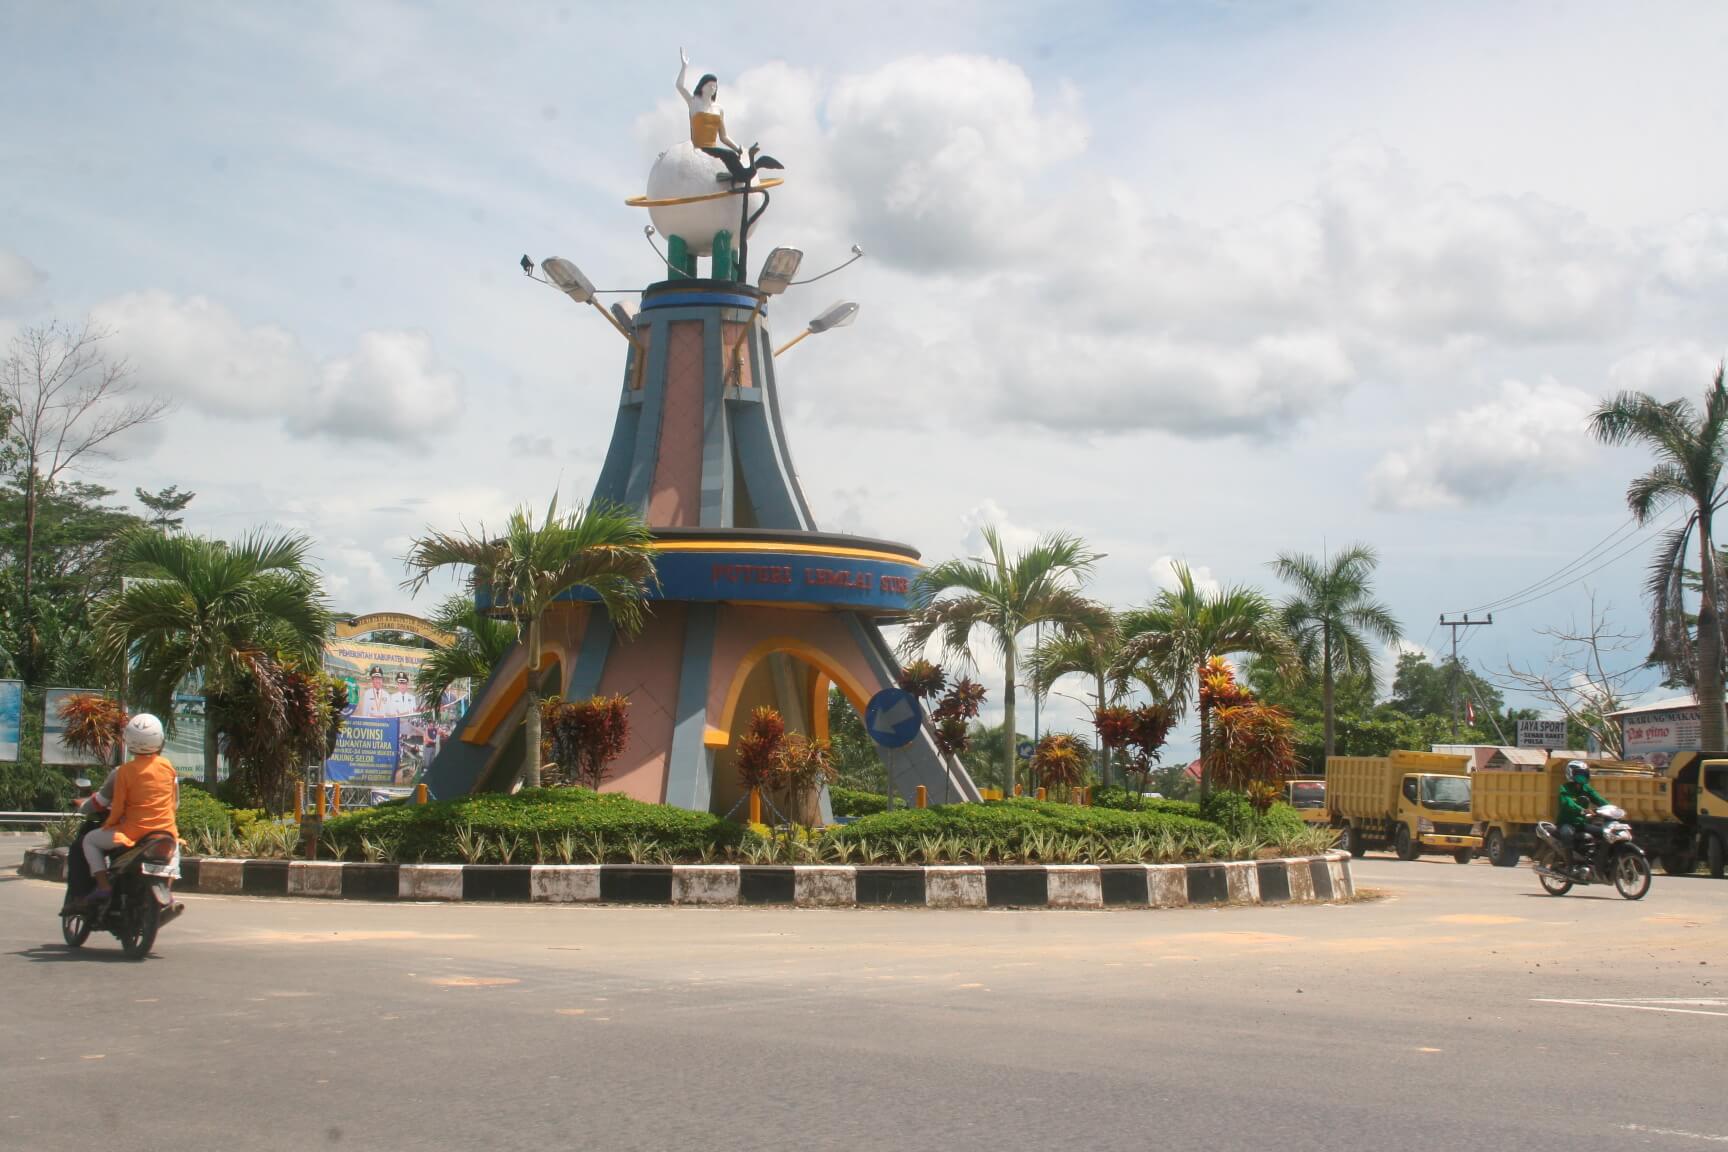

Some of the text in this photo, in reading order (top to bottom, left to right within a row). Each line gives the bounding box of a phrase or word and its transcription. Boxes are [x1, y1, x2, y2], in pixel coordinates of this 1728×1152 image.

[1520, 721, 1565, 732] JAYA SPORT
[341, 727, 384, 741] PROVINSI
[335, 739, 392, 750] ALIMANTAN UTARA
